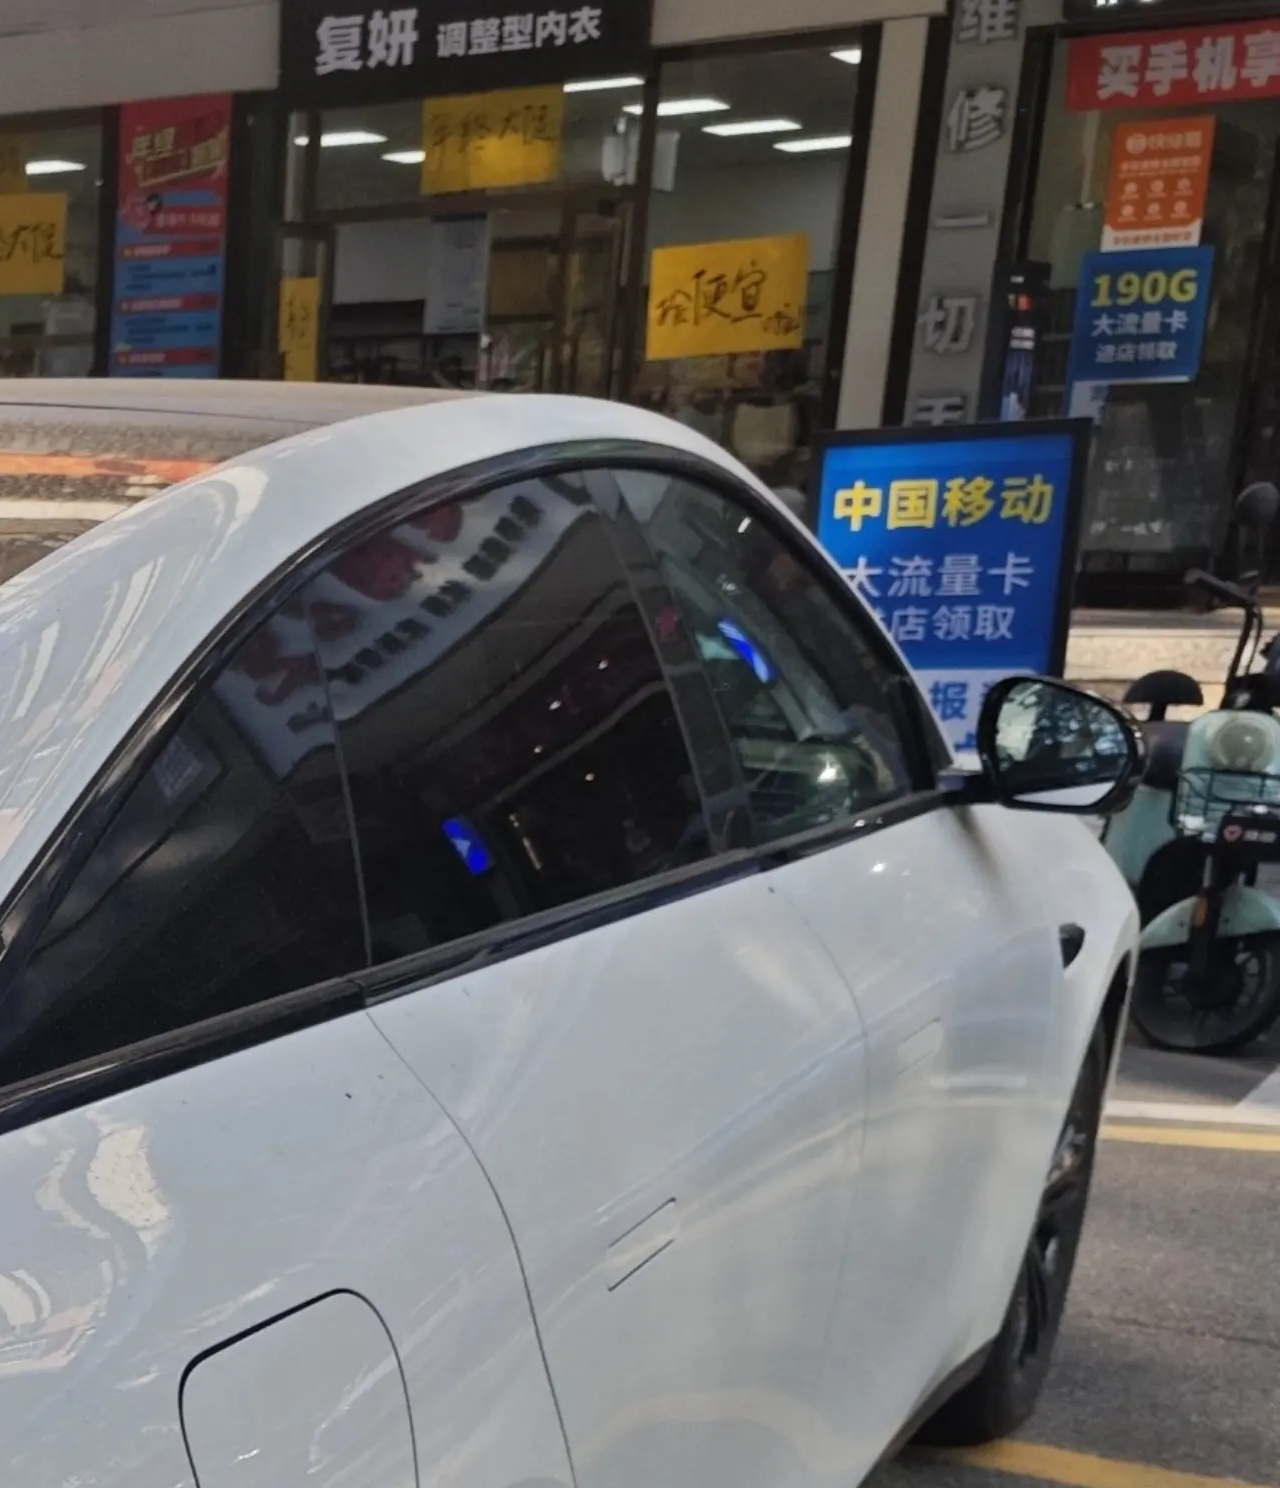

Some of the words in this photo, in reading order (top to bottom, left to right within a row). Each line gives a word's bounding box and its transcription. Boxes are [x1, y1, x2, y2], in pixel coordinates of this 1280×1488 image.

[315, 8, 418, 76] 复妍
[436, 5, 602, 58] 调整型内衣
[1097, 30, 1280, 100] 买手机享
[1090, 268, 1198, 307] 190G
[1091, 309, 1189, 337] 大流量卡
[833, 474, 1054, 532] 中国移动
[841, 552, 1034, 598] 大流量卡
